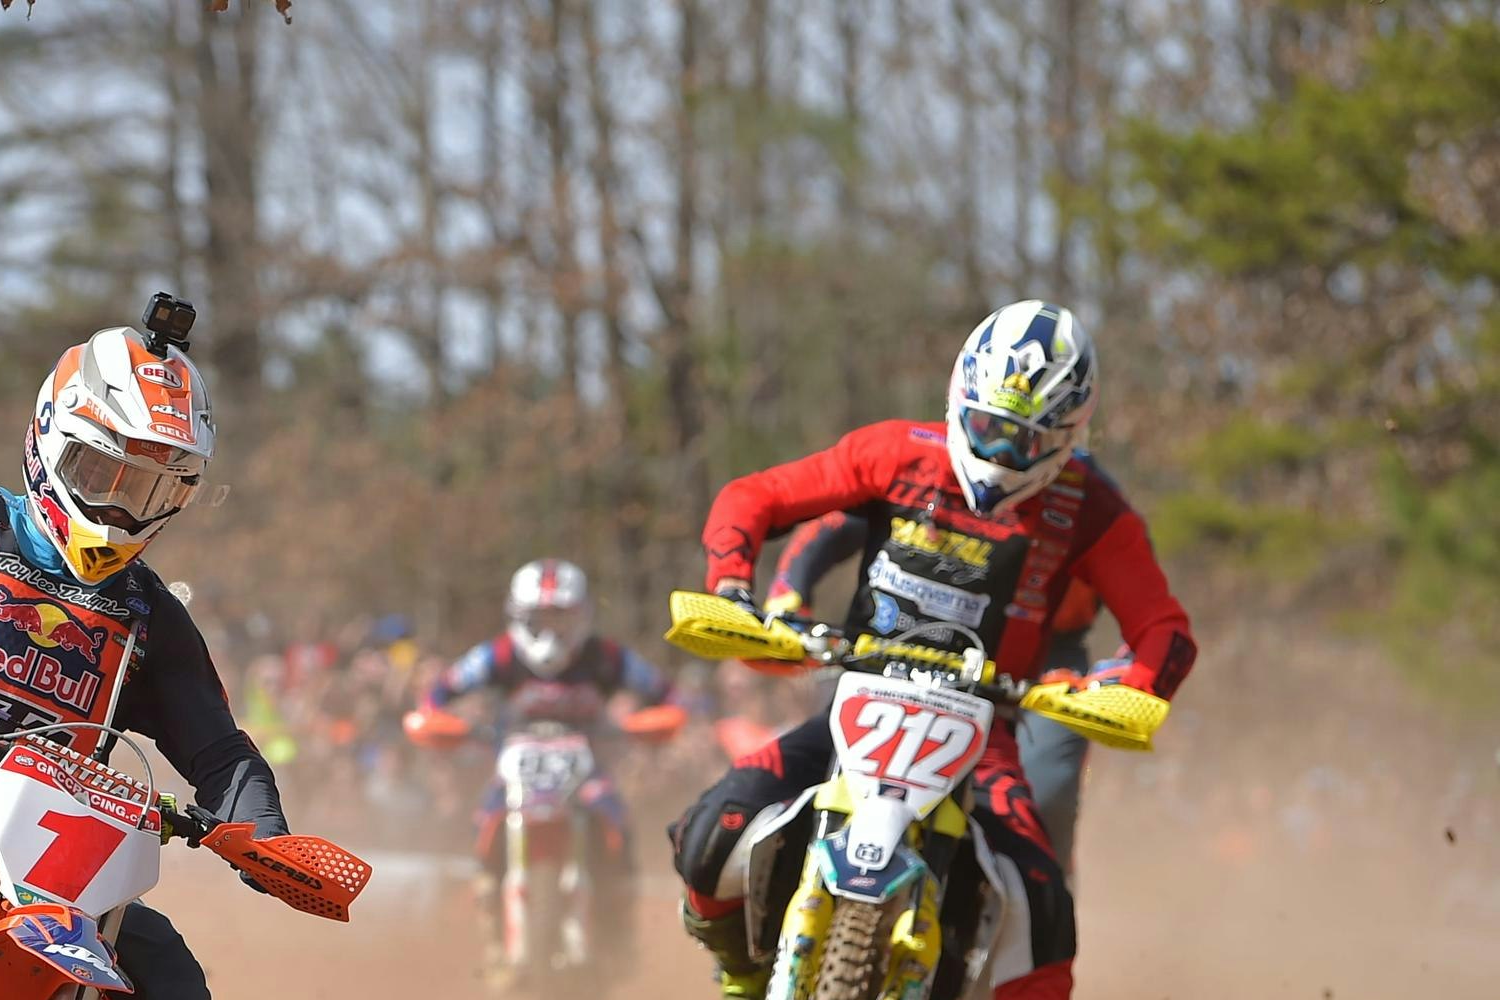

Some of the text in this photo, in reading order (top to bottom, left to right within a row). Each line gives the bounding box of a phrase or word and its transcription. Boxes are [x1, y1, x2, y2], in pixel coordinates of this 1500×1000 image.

[143, 367, 178, 386] BELL
[151, 405, 188, 420] KTM
[155, 424, 191, 442] BELL
[28, 571, 57, 596] Lee
[59, 585, 130, 616] Designs
[30, 653, 100, 713] Bull
[848, 700, 976, 791] 212
[23, 809, 127, 902] 1
[242, 851, 323, 890] ACERBIS
[43, 943, 118, 981] KTM
